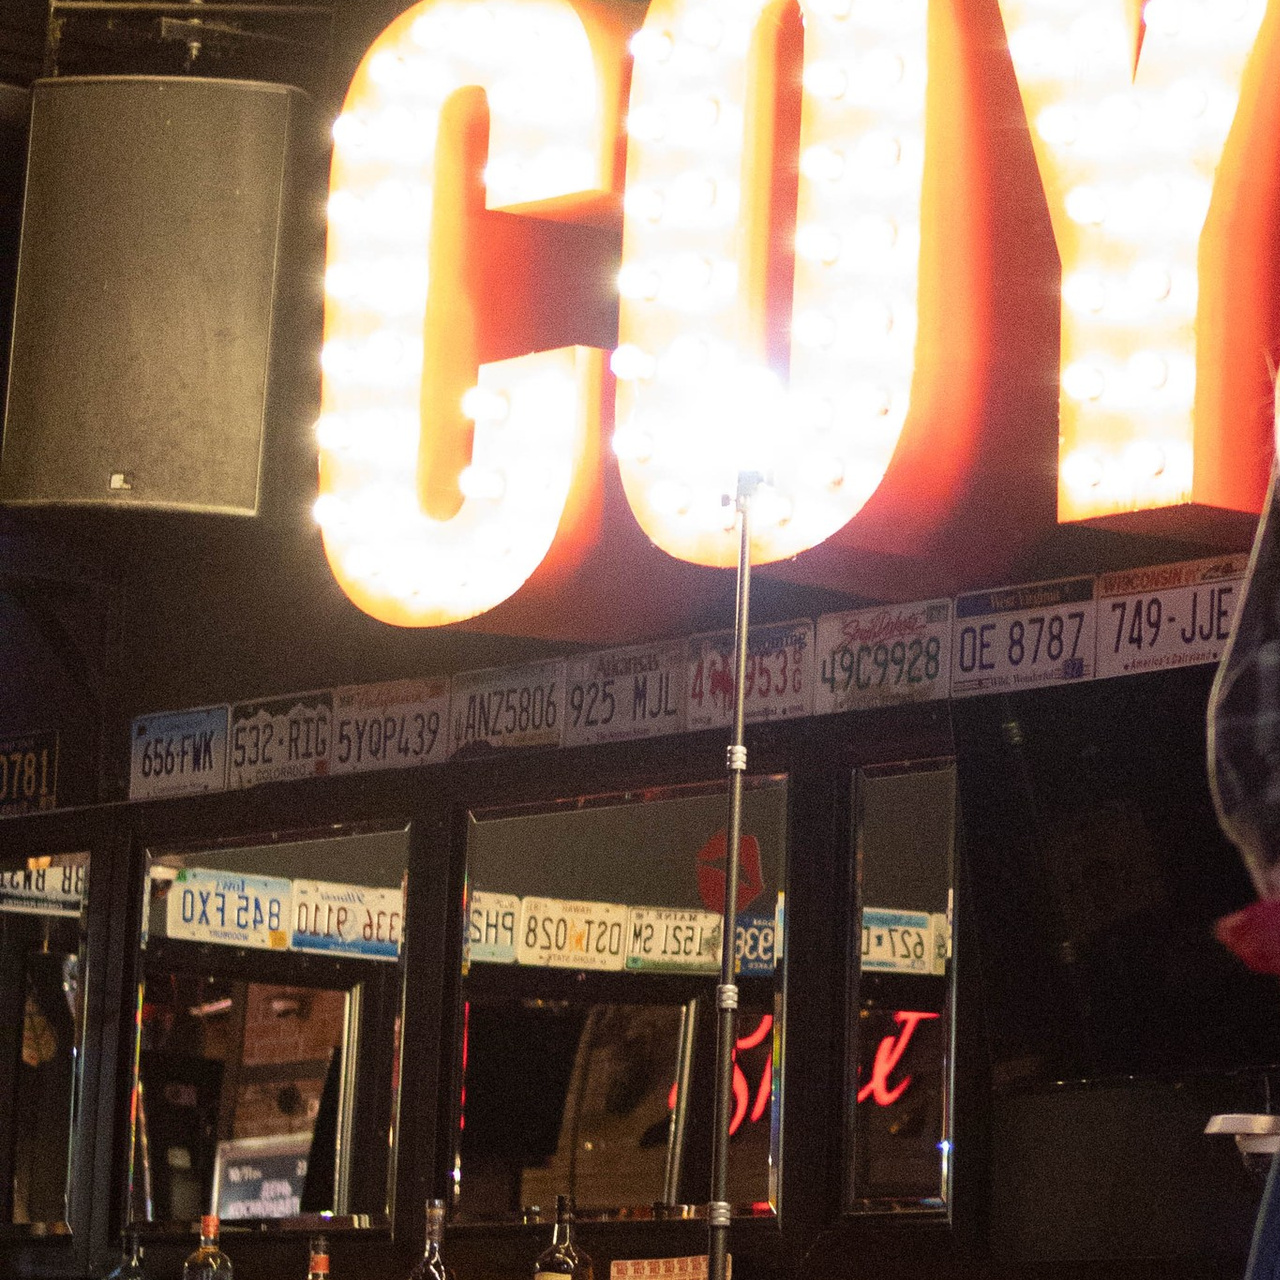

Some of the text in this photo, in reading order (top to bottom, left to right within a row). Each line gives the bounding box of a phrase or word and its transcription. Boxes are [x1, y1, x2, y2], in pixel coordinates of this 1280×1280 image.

[1102, 567, 1185, 593] WISCONSIN
[1008, 612, 1085, 666] 8787
[1112, 587, 1232, 653] 749-JJE
[597, 653, 660, 677] Arkansas
[465, 682, 557, 740] ANZ5806
[570, 673, 677, 727] 925 MJL
[339, 712, 440, 763] 5YQP439
